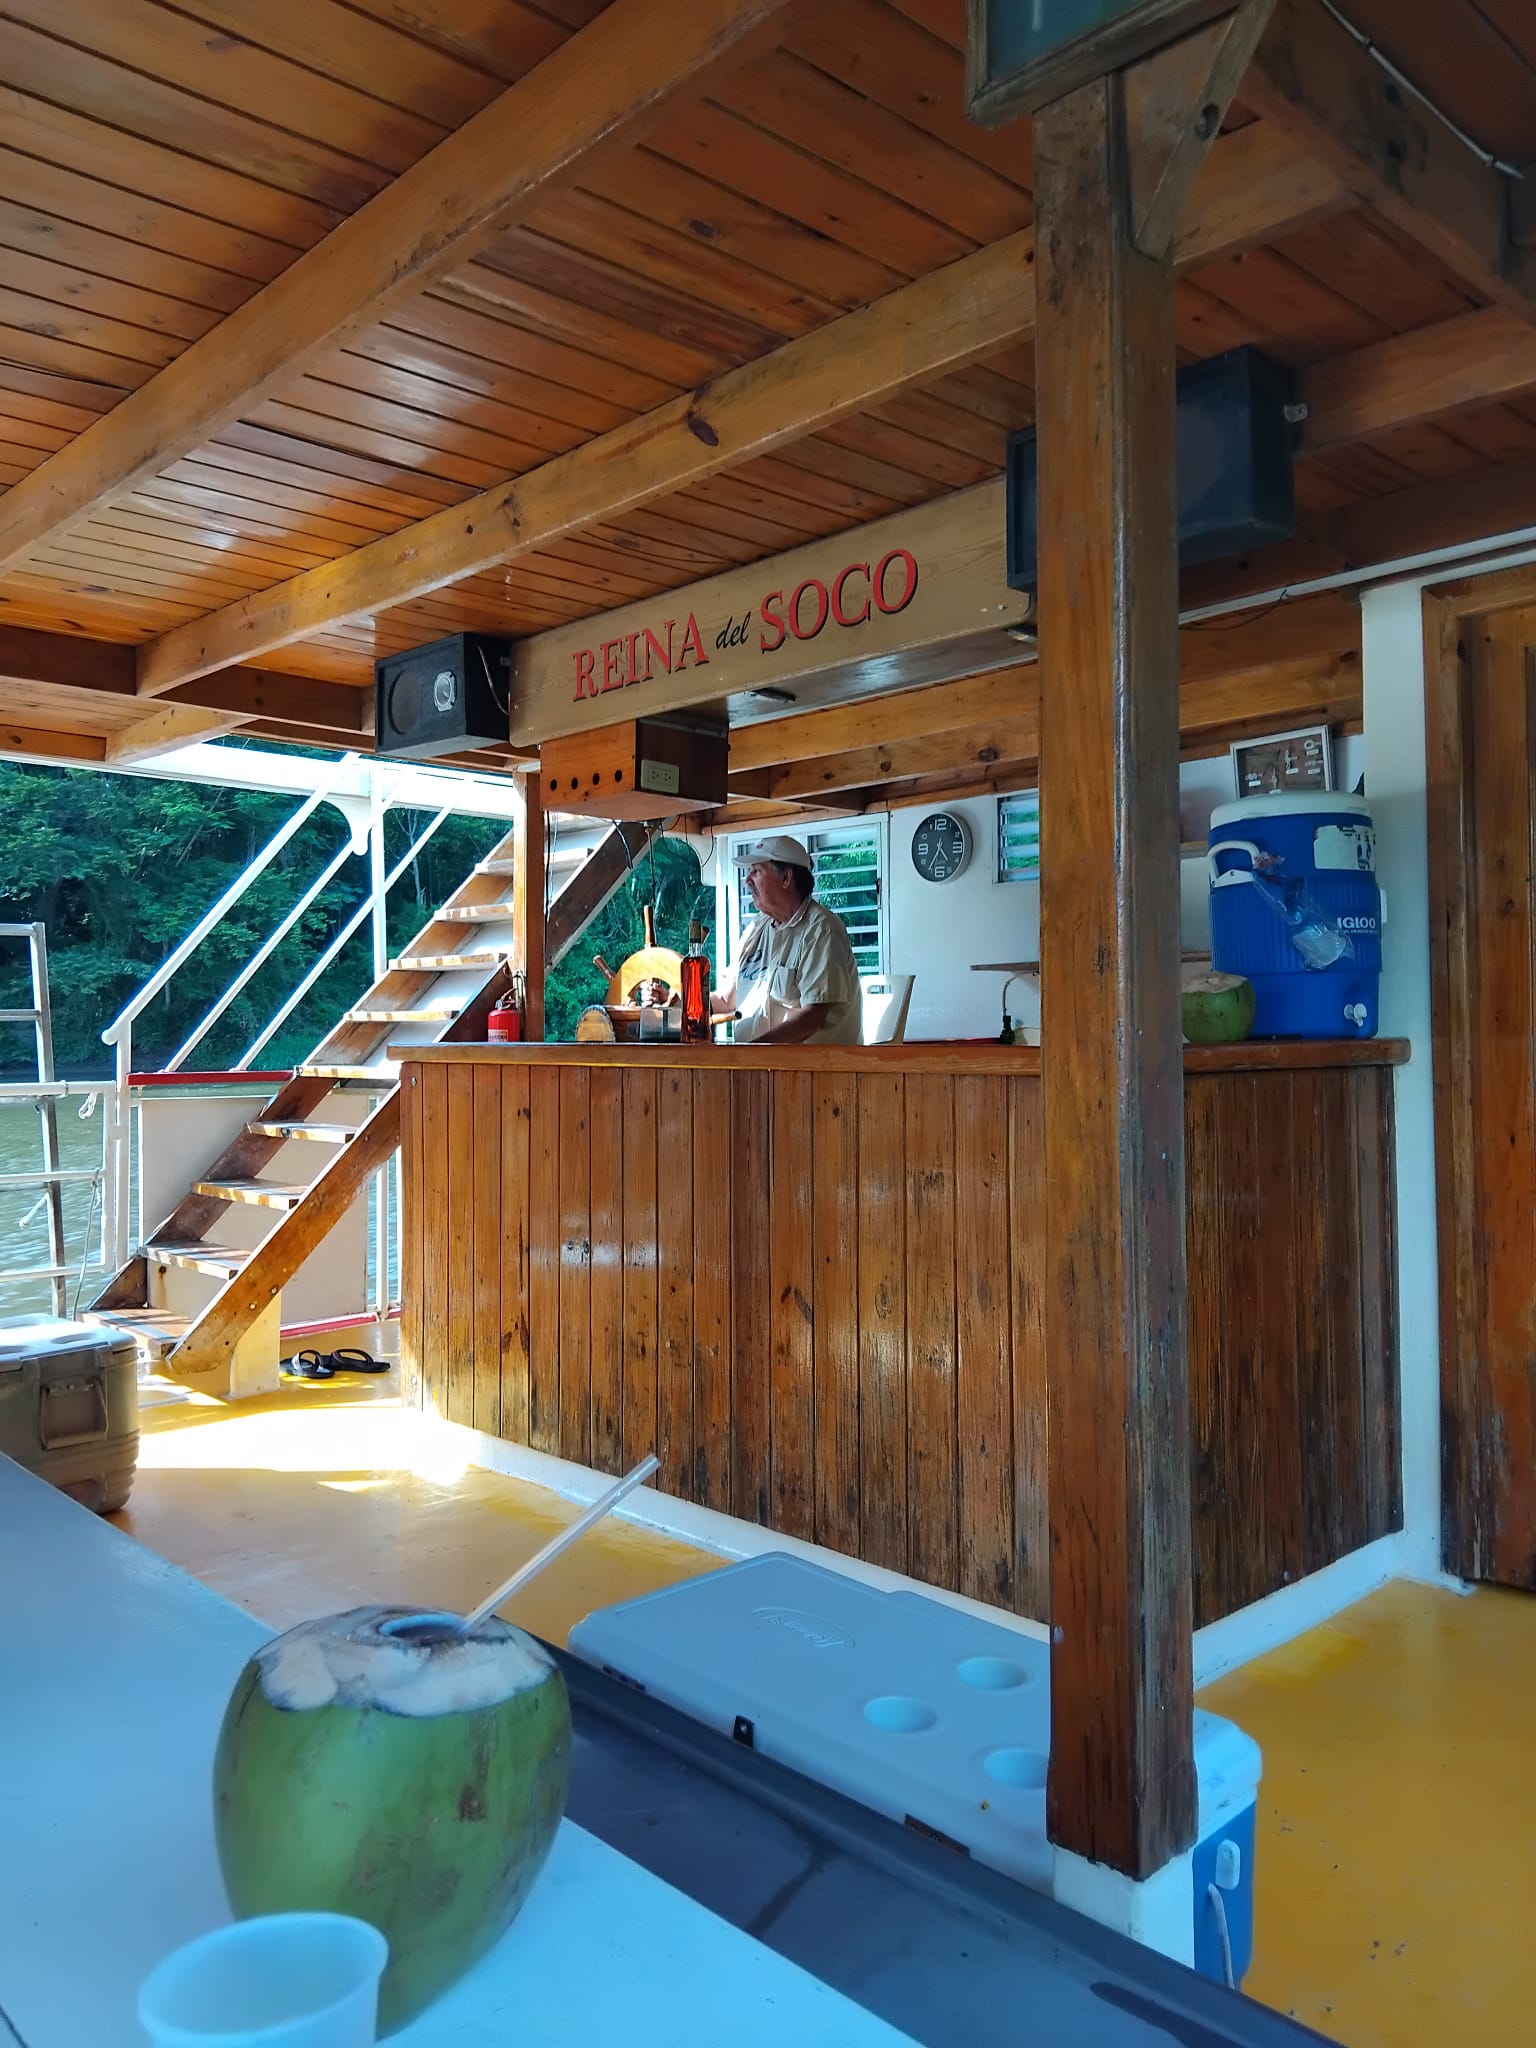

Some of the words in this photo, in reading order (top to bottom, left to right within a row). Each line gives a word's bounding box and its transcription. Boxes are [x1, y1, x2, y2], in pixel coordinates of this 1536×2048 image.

[572, 612, 709, 702] REINA
[715, 611, 751, 650] del
[759, 548, 919, 655] SOCO
[934, 818, 947, 831] 12
[918, 843, 929, 855] 9
[952, 841, 963, 854] 3
[934, 866, 945, 878] 6
[1336, 916, 1376, 929] IGLOO
